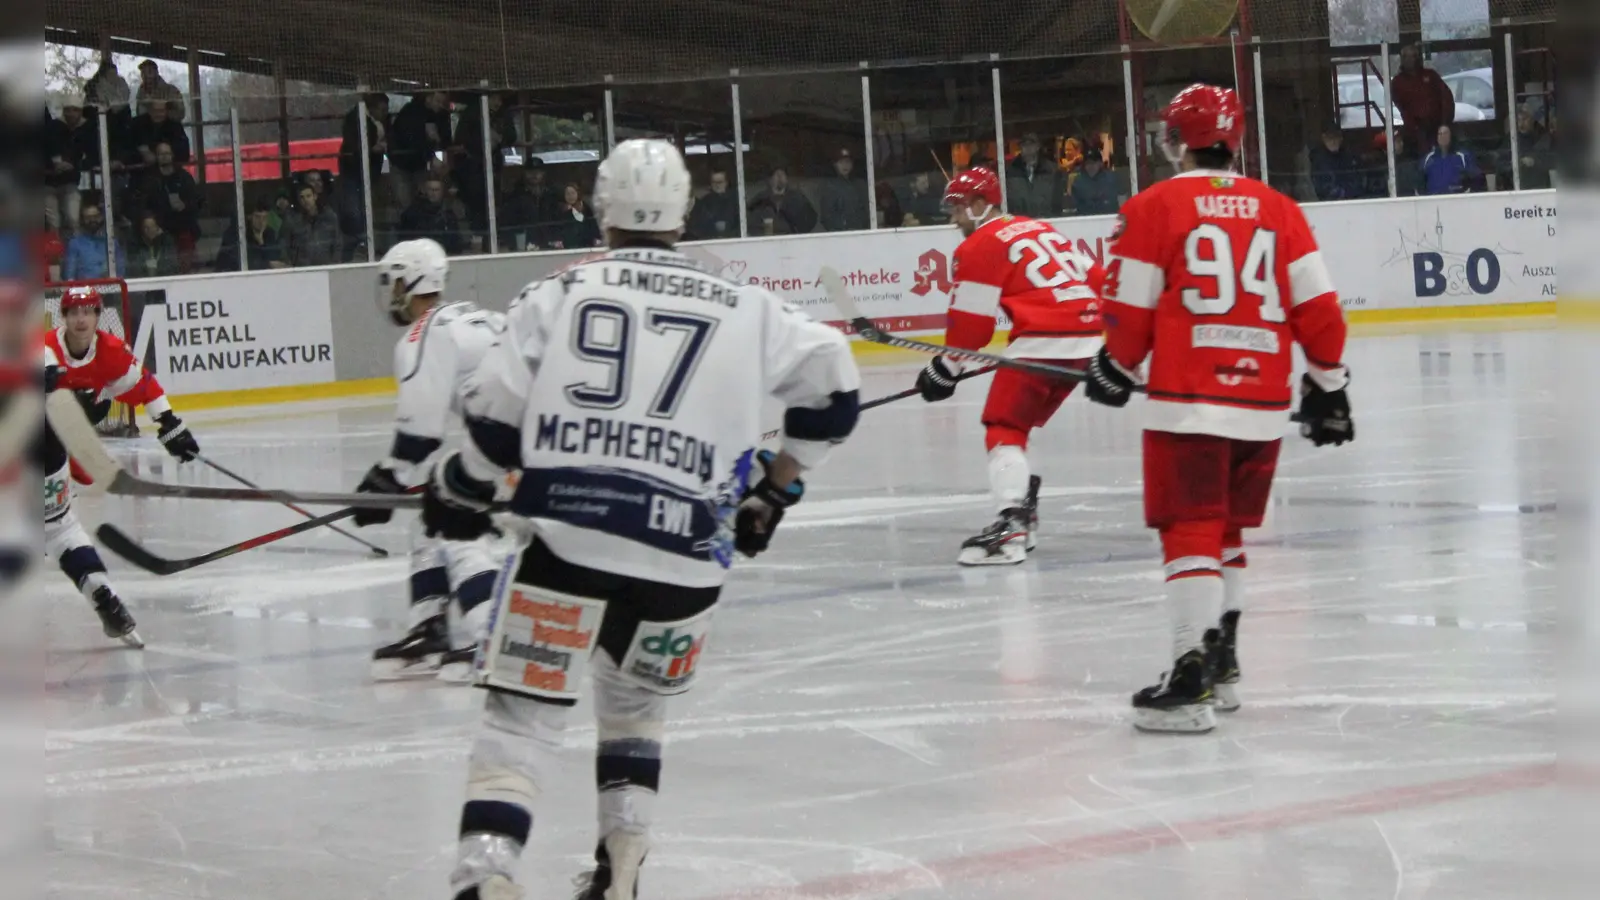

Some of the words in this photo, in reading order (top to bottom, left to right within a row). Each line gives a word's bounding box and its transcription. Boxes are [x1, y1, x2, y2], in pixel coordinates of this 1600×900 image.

[634, 209, 662, 224] 97
[1504, 205, 1543, 219] Bereit
[1008, 231, 1095, 289] 26
[1181, 223, 1286, 323] 94
[1413, 247, 1500, 297] B&O
[602, 266, 741, 308] LANDSBERG
[166, 299, 230, 322] LIEDL
[168, 323, 257, 348] METALL
[169, 343, 332, 374] MANUFAKTUR
[564, 298, 720, 420] 97
[535, 413, 717, 483] McPHERSON
[648, 494, 694, 538] EWL
[641, 627, 693, 657] do
